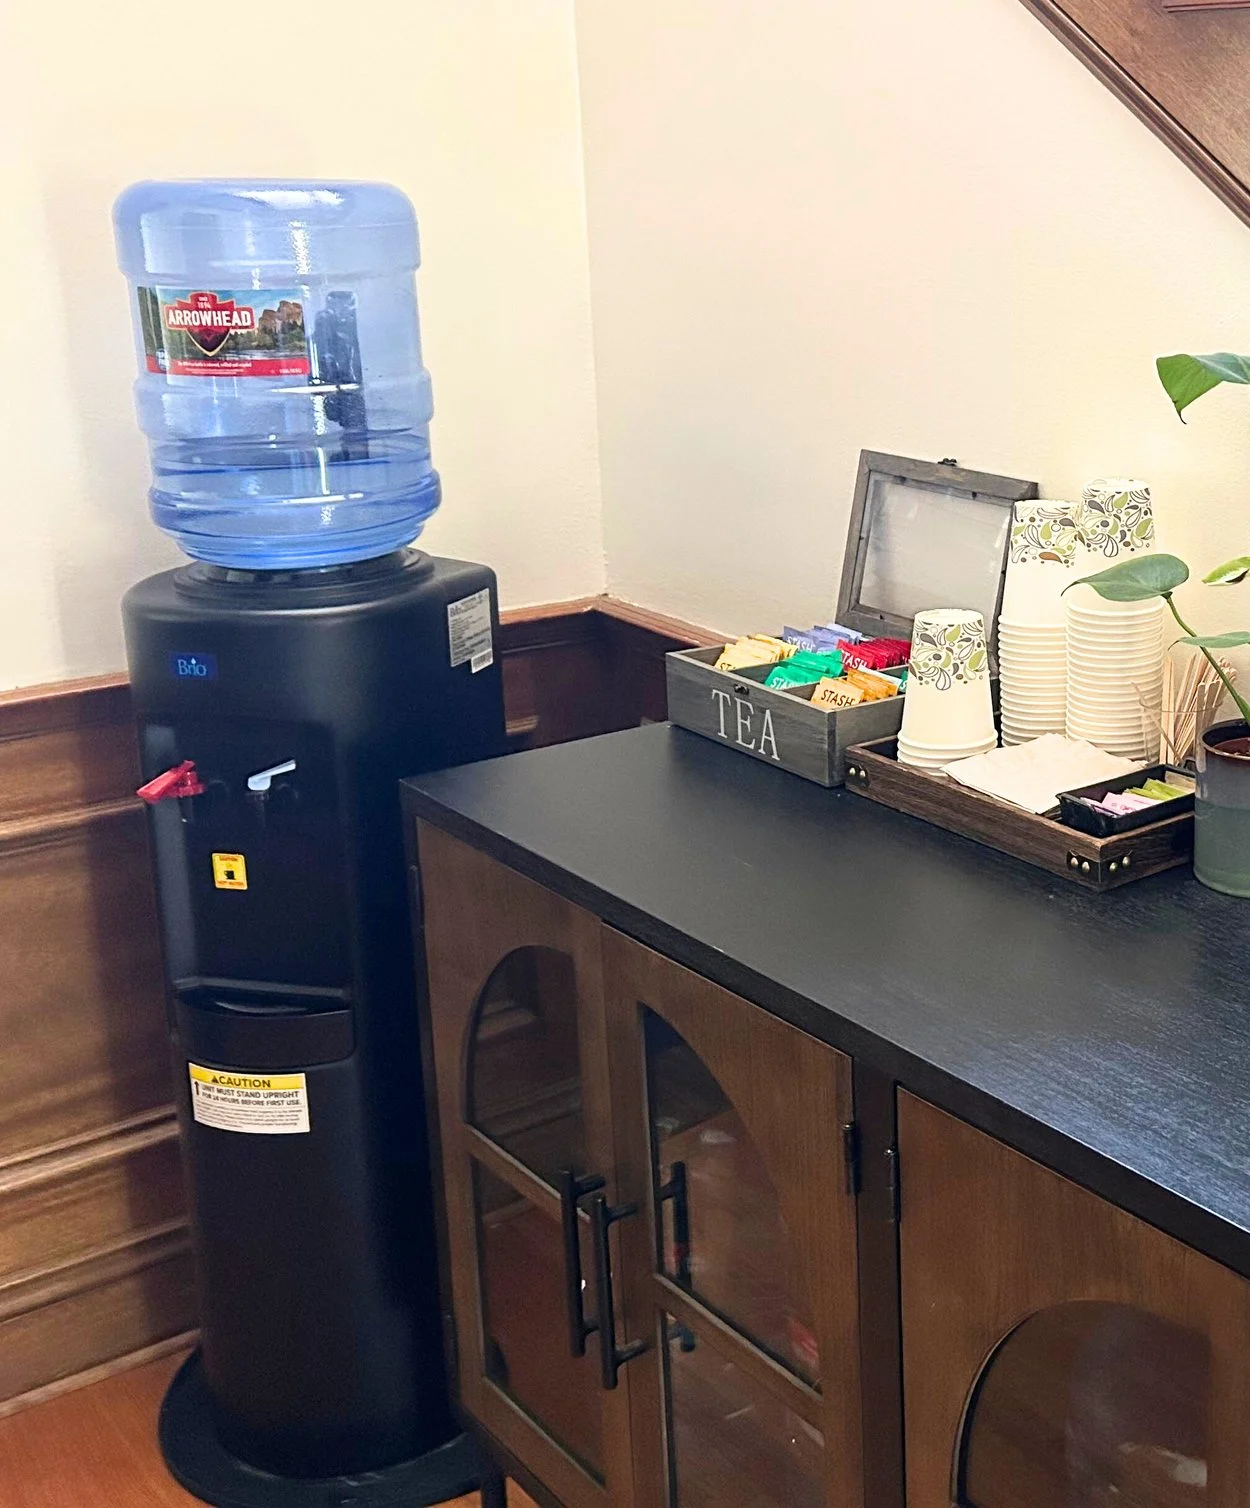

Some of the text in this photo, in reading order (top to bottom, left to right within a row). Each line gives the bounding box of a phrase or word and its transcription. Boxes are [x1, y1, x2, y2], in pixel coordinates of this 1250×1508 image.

[168, 309, 252, 327] ARROWHEAD
[177, 657, 207, 677] Brio
[841, 649, 868, 669] TASH
[821, 689, 855, 707] STASH
[712, 689, 781, 761] TEA
[218, 1075, 271, 1088] CAUTION
[216, 1088, 235, 1096] MUST
[237, 1090, 261, 1099] STAND
[262, 1091, 299, 1099] UPRIGHT
